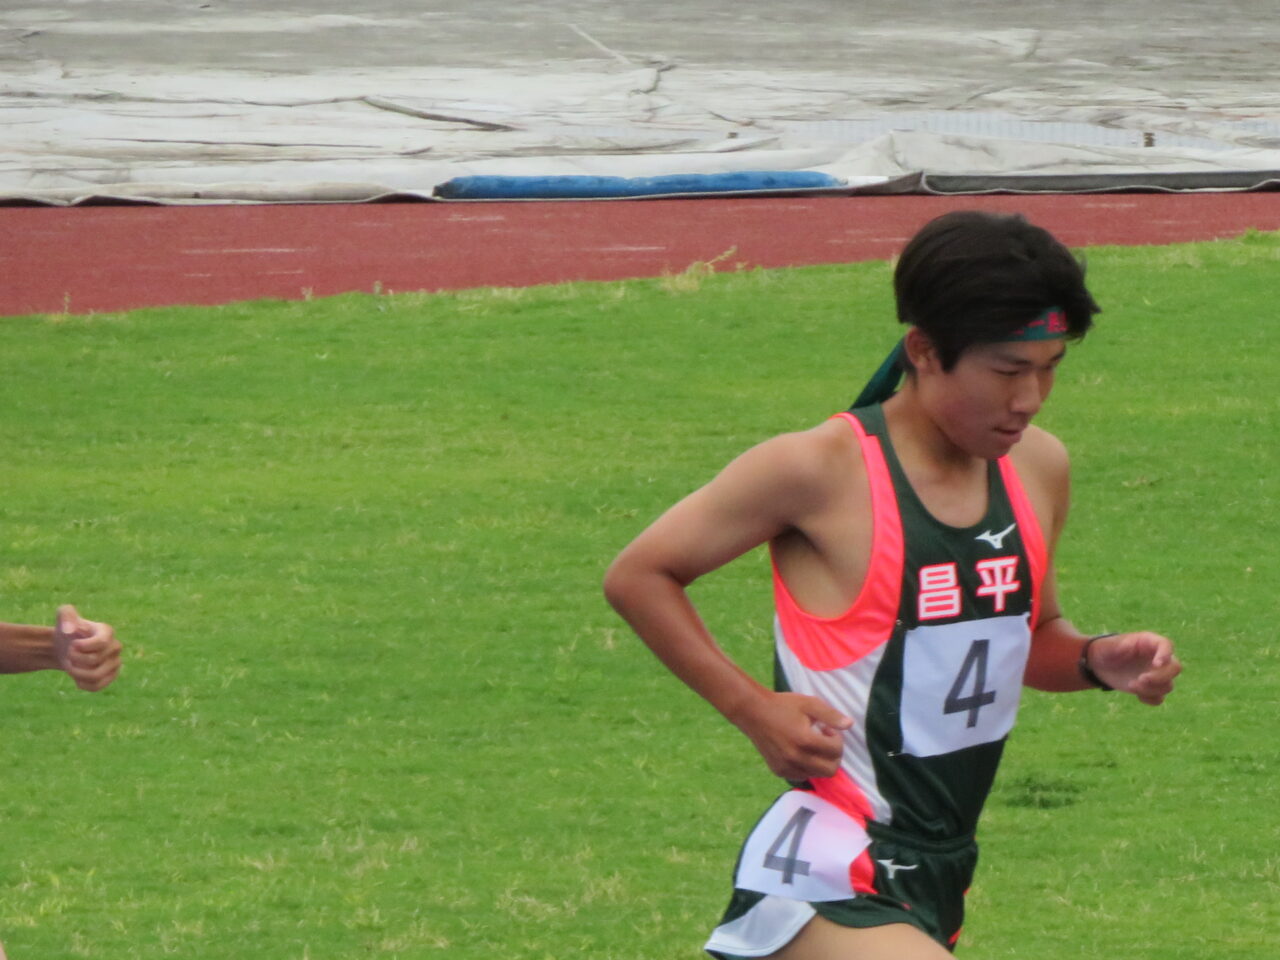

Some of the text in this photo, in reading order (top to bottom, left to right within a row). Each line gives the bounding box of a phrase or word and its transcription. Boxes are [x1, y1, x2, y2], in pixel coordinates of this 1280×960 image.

[918, 556, 1021, 621] 昌平
[943, 638, 997, 729] 4
[763, 805, 817, 886] 4
